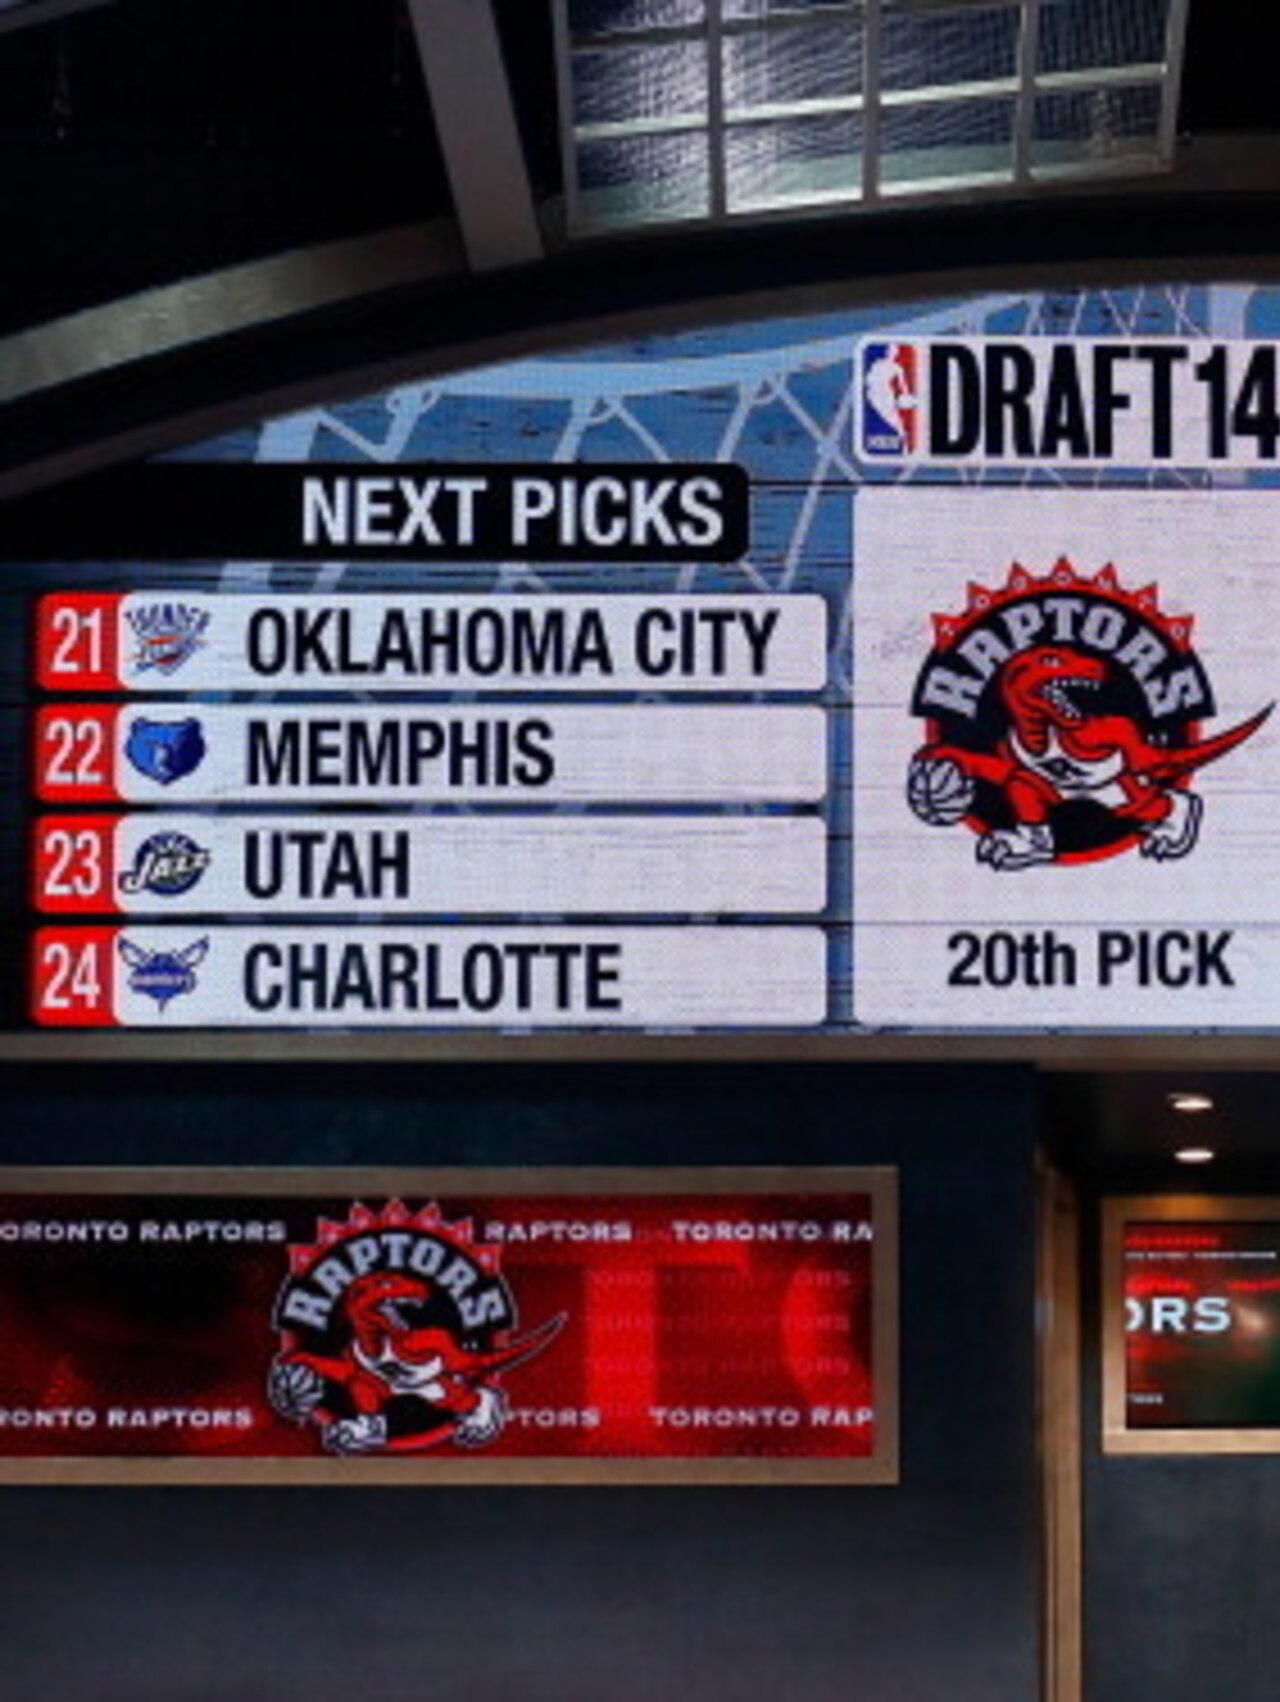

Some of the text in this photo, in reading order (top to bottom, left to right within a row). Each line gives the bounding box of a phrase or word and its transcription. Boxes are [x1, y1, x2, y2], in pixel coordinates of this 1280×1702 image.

[303, 478, 723, 546] NEXT PICKS
[51, 607, 102, 673] 21
[247, 607, 780, 677] OKLAHOMA CITY
[920, 597, 1205, 719] RAPTORS
[45, 718, 555, 787] 22 MEMPHIS
[44, 830, 101, 897] 23
[244, 830, 410, 900] UTAH
[42, 942, 622, 1012] 24 CHARLOTTE
[946, 930, 1236, 988] 20th PICK
[139, 1221, 286, 1241] RAPTORS
[485, 1221, 632, 1241] RAPTORS
[671, 1221, 822, 1241] TORONTO
[283, 1232, 506, 1331] RAPTORS
[107, 1408, 253, 1428] RAPTORS
[649, 1407, 800, 1427] TORONTO
